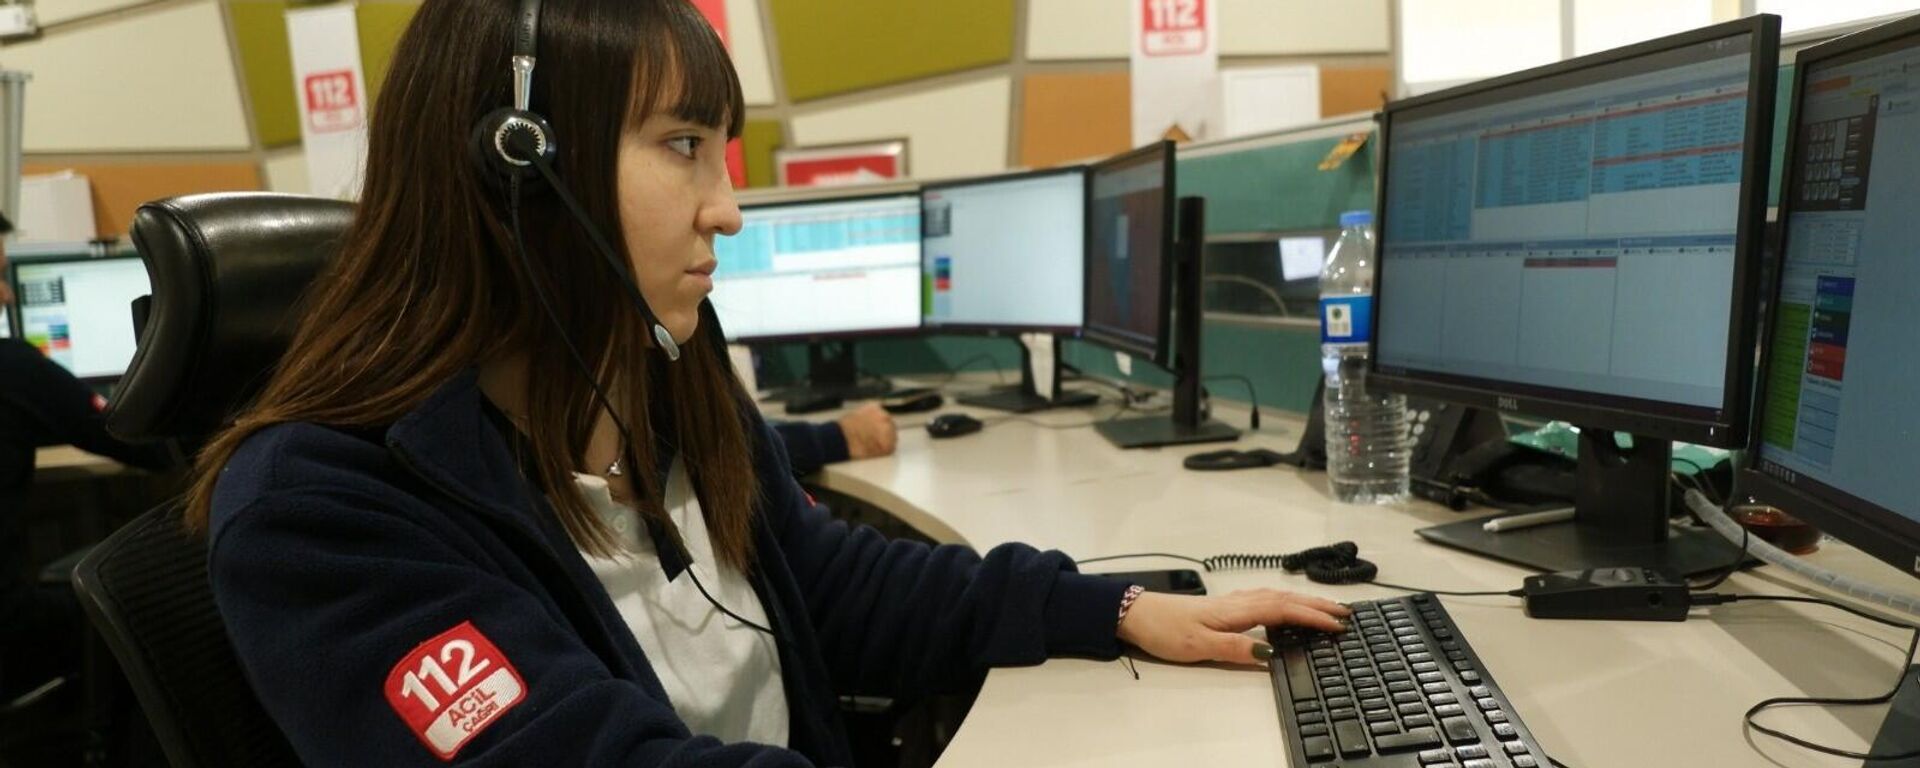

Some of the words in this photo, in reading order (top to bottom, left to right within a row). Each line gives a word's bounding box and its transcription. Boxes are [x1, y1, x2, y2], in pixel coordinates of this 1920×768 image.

[1150, 0, 1198, 28] 112
[310, 76, 351, 108] 112
[1498, 396, 1519, 411] DELL
[402, 639, 490, 712] 112
